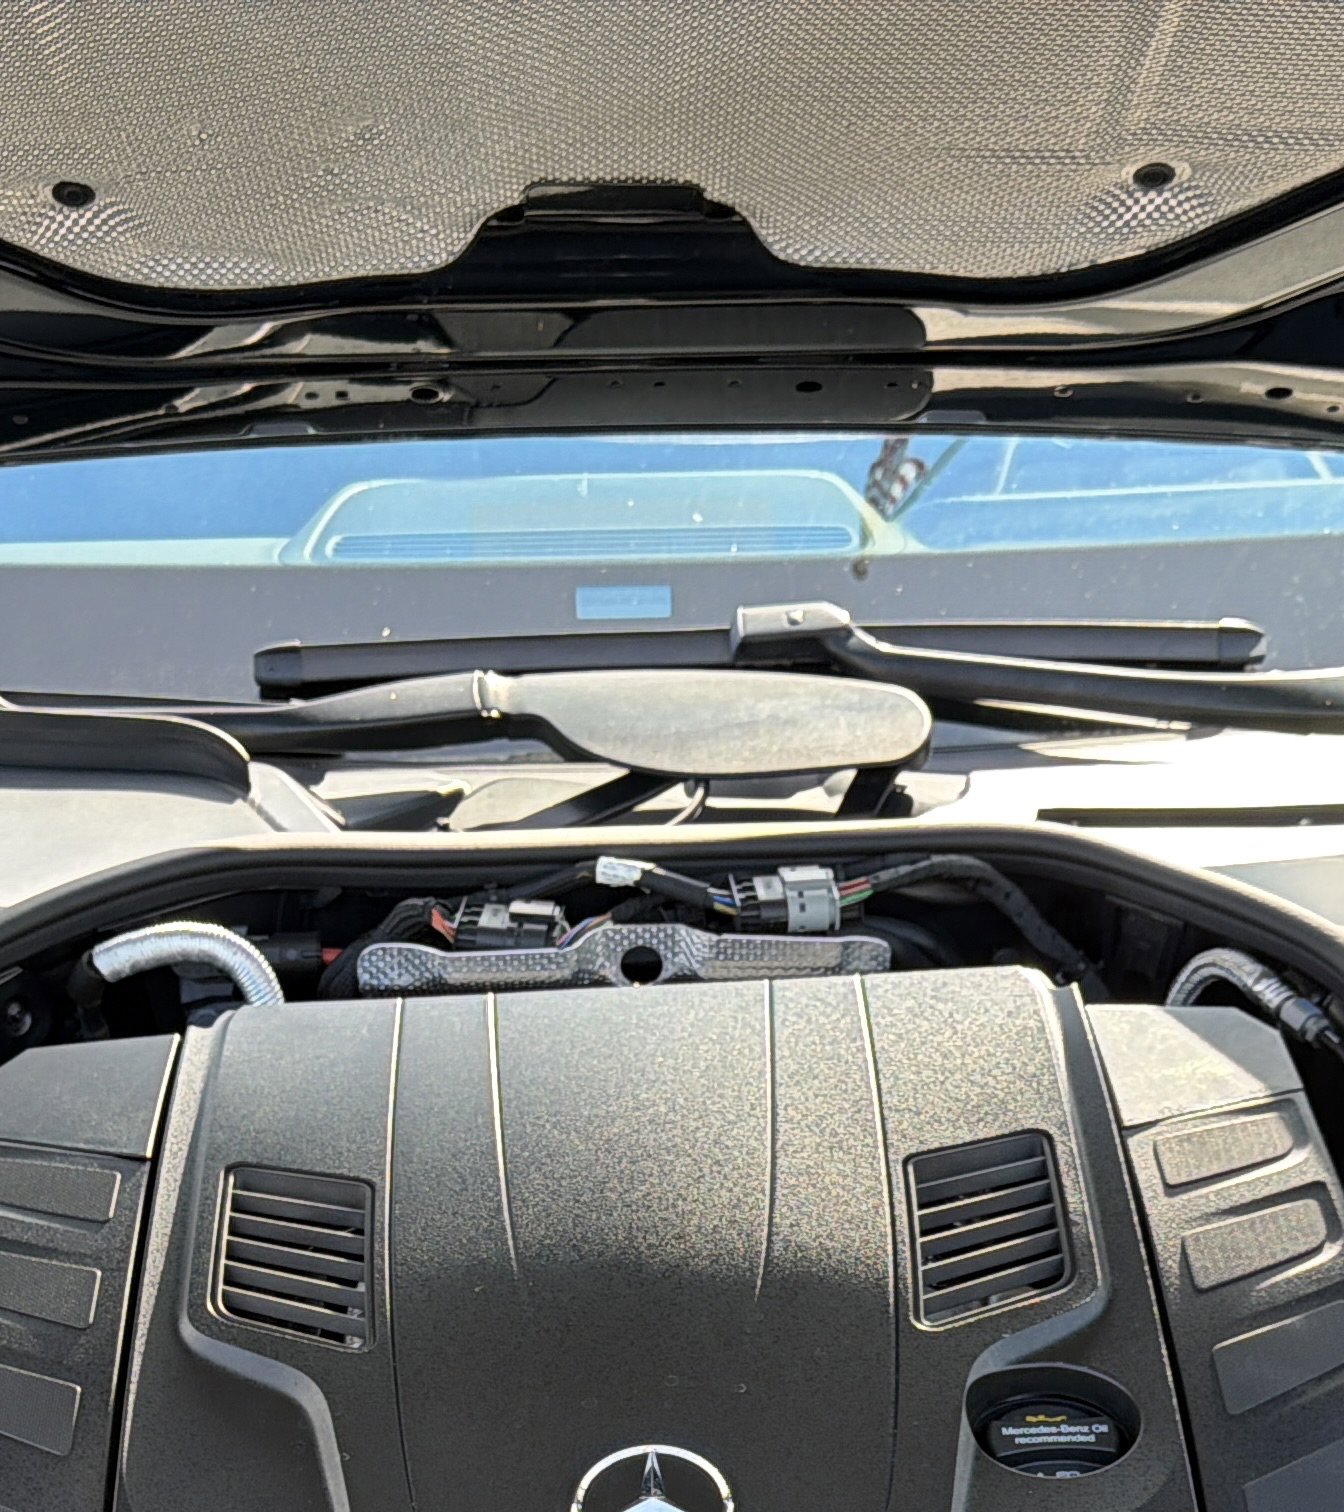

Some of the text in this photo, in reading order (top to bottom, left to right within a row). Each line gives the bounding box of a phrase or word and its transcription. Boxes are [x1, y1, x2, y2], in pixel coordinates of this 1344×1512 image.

[1001, 1424, 1109, 1435] Mercedes-Benz Oil
[1014, 1434, 1096, 1444] recommended
